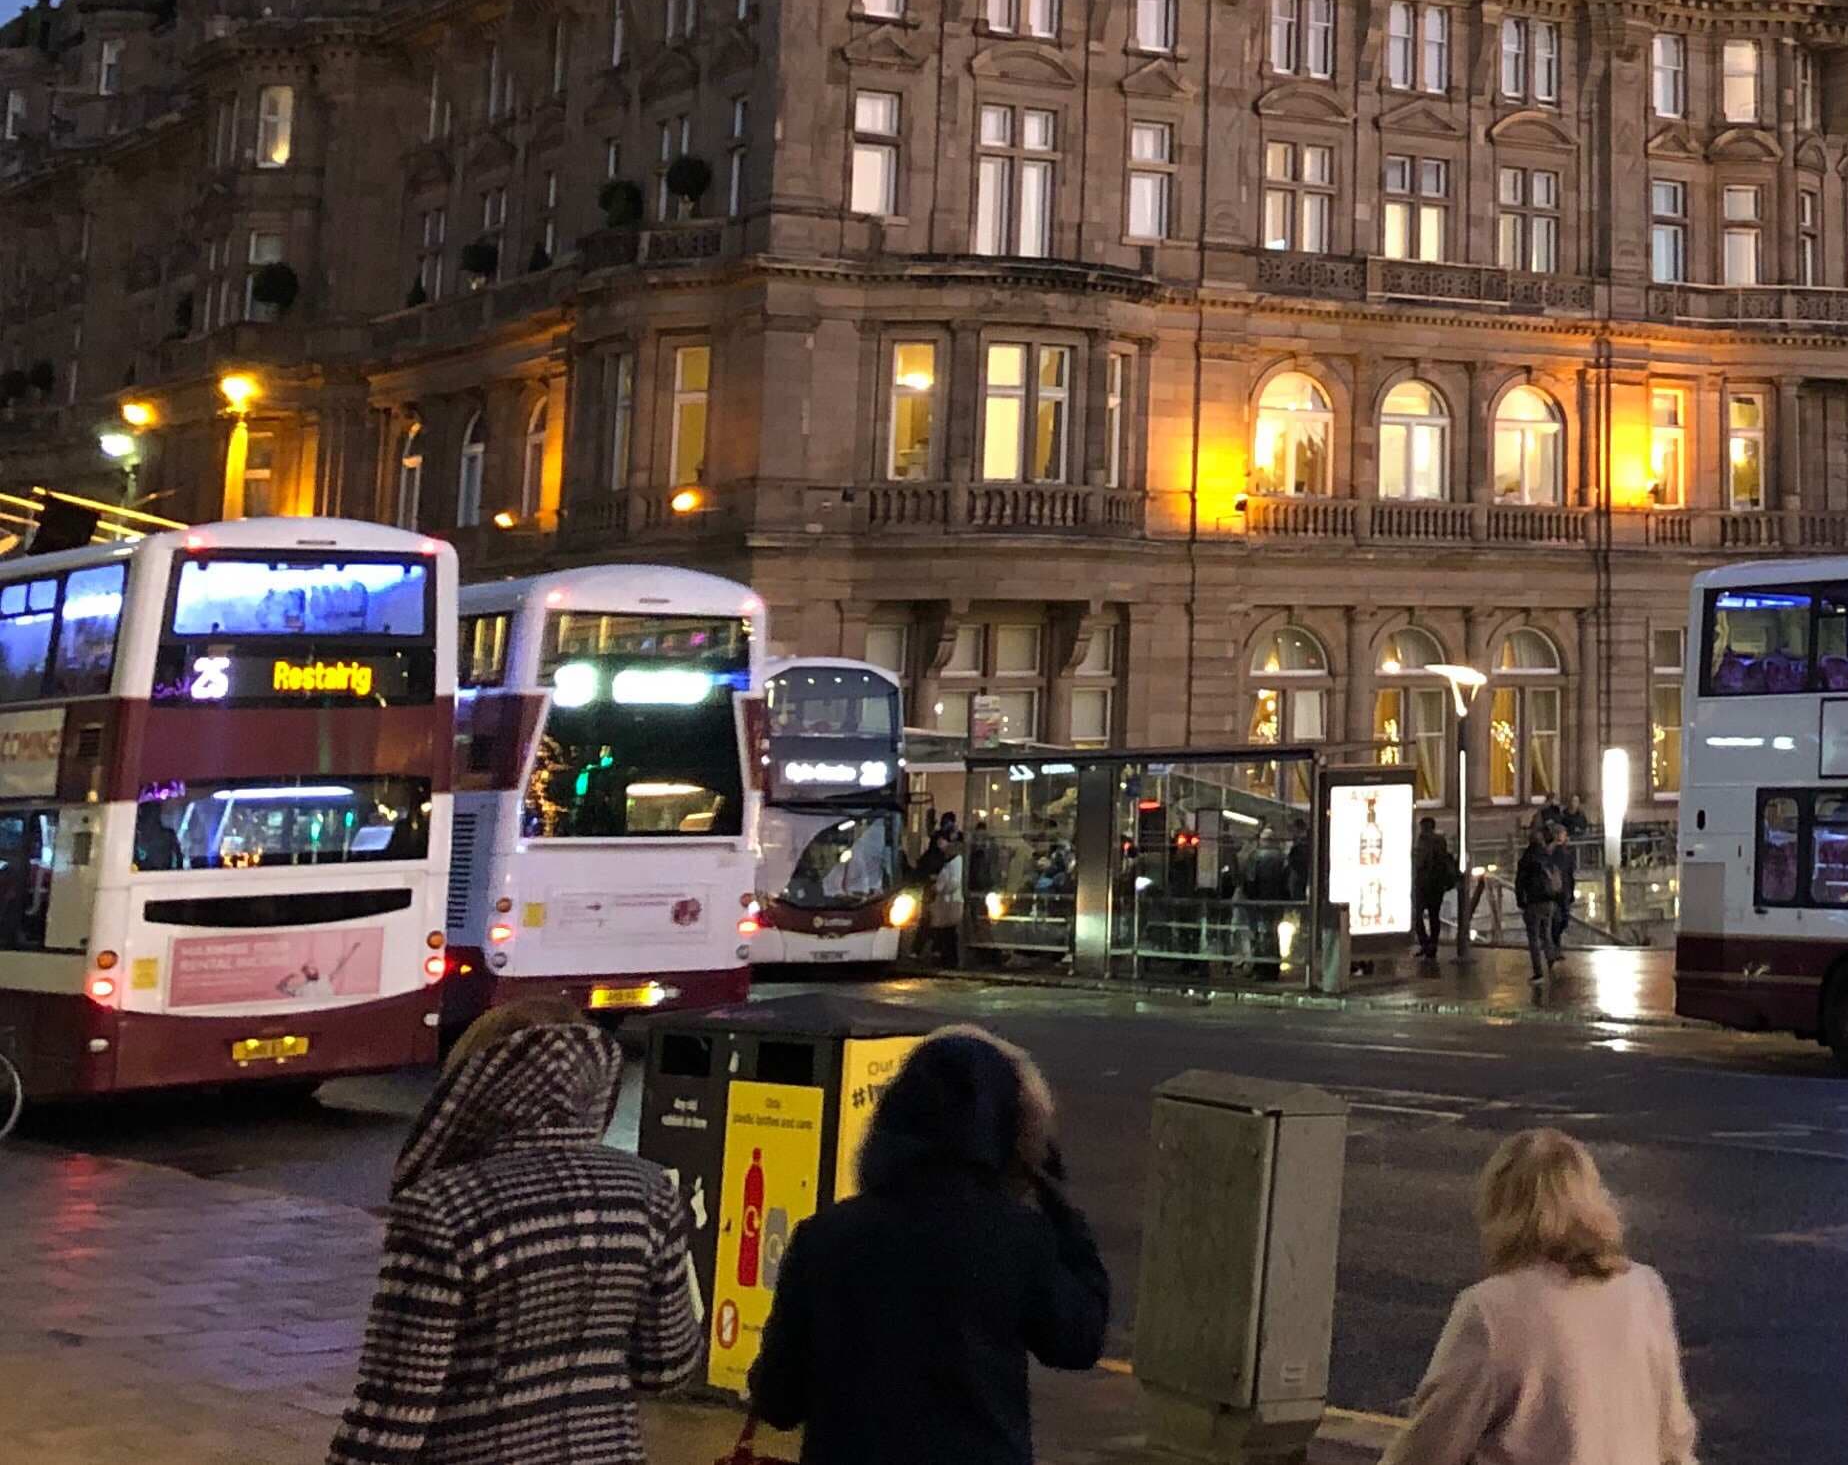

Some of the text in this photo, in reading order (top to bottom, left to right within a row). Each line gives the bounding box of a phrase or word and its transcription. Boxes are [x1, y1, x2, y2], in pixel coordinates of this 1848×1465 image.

[190, 656, 373, 700] 25 Restalrig
[867, 1059, 894, 1076] Our
